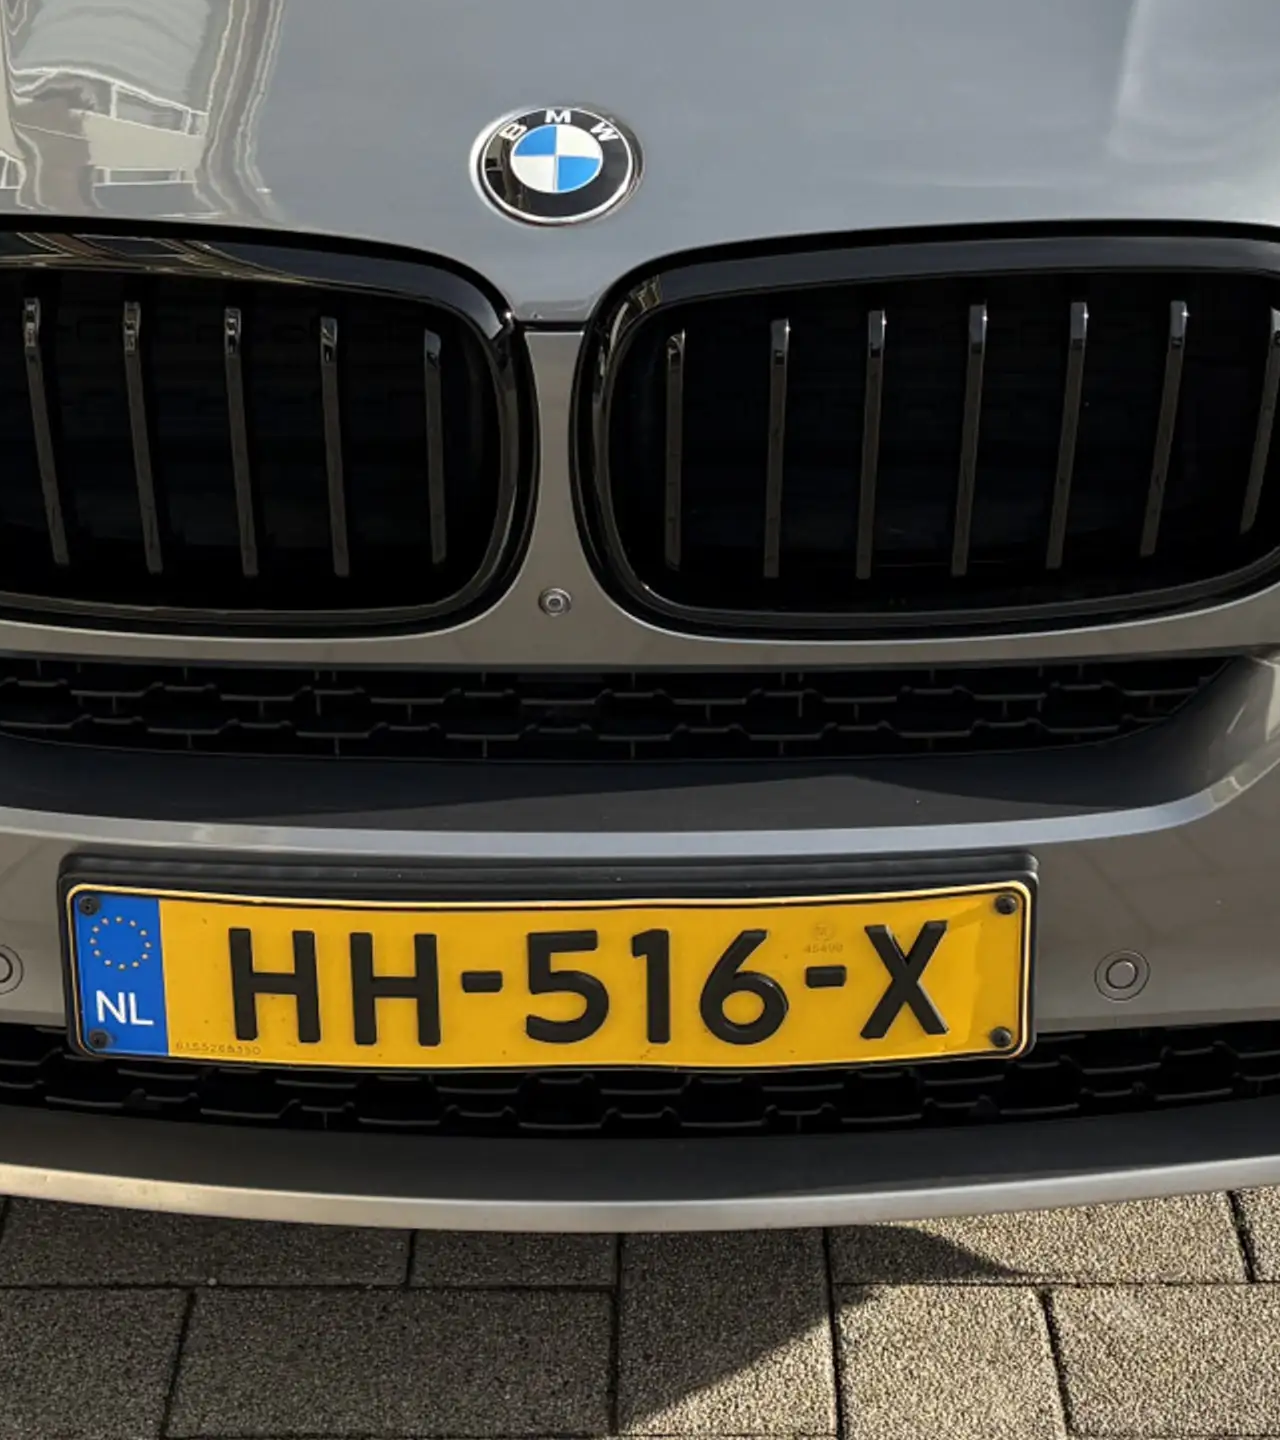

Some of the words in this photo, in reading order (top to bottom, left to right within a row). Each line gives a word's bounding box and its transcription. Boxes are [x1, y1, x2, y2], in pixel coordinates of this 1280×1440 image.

[498, 109, 620, 142] BMW
[228, 919, 949, 1046] HH-516-X
[95, 989, 155, 1026] NL
